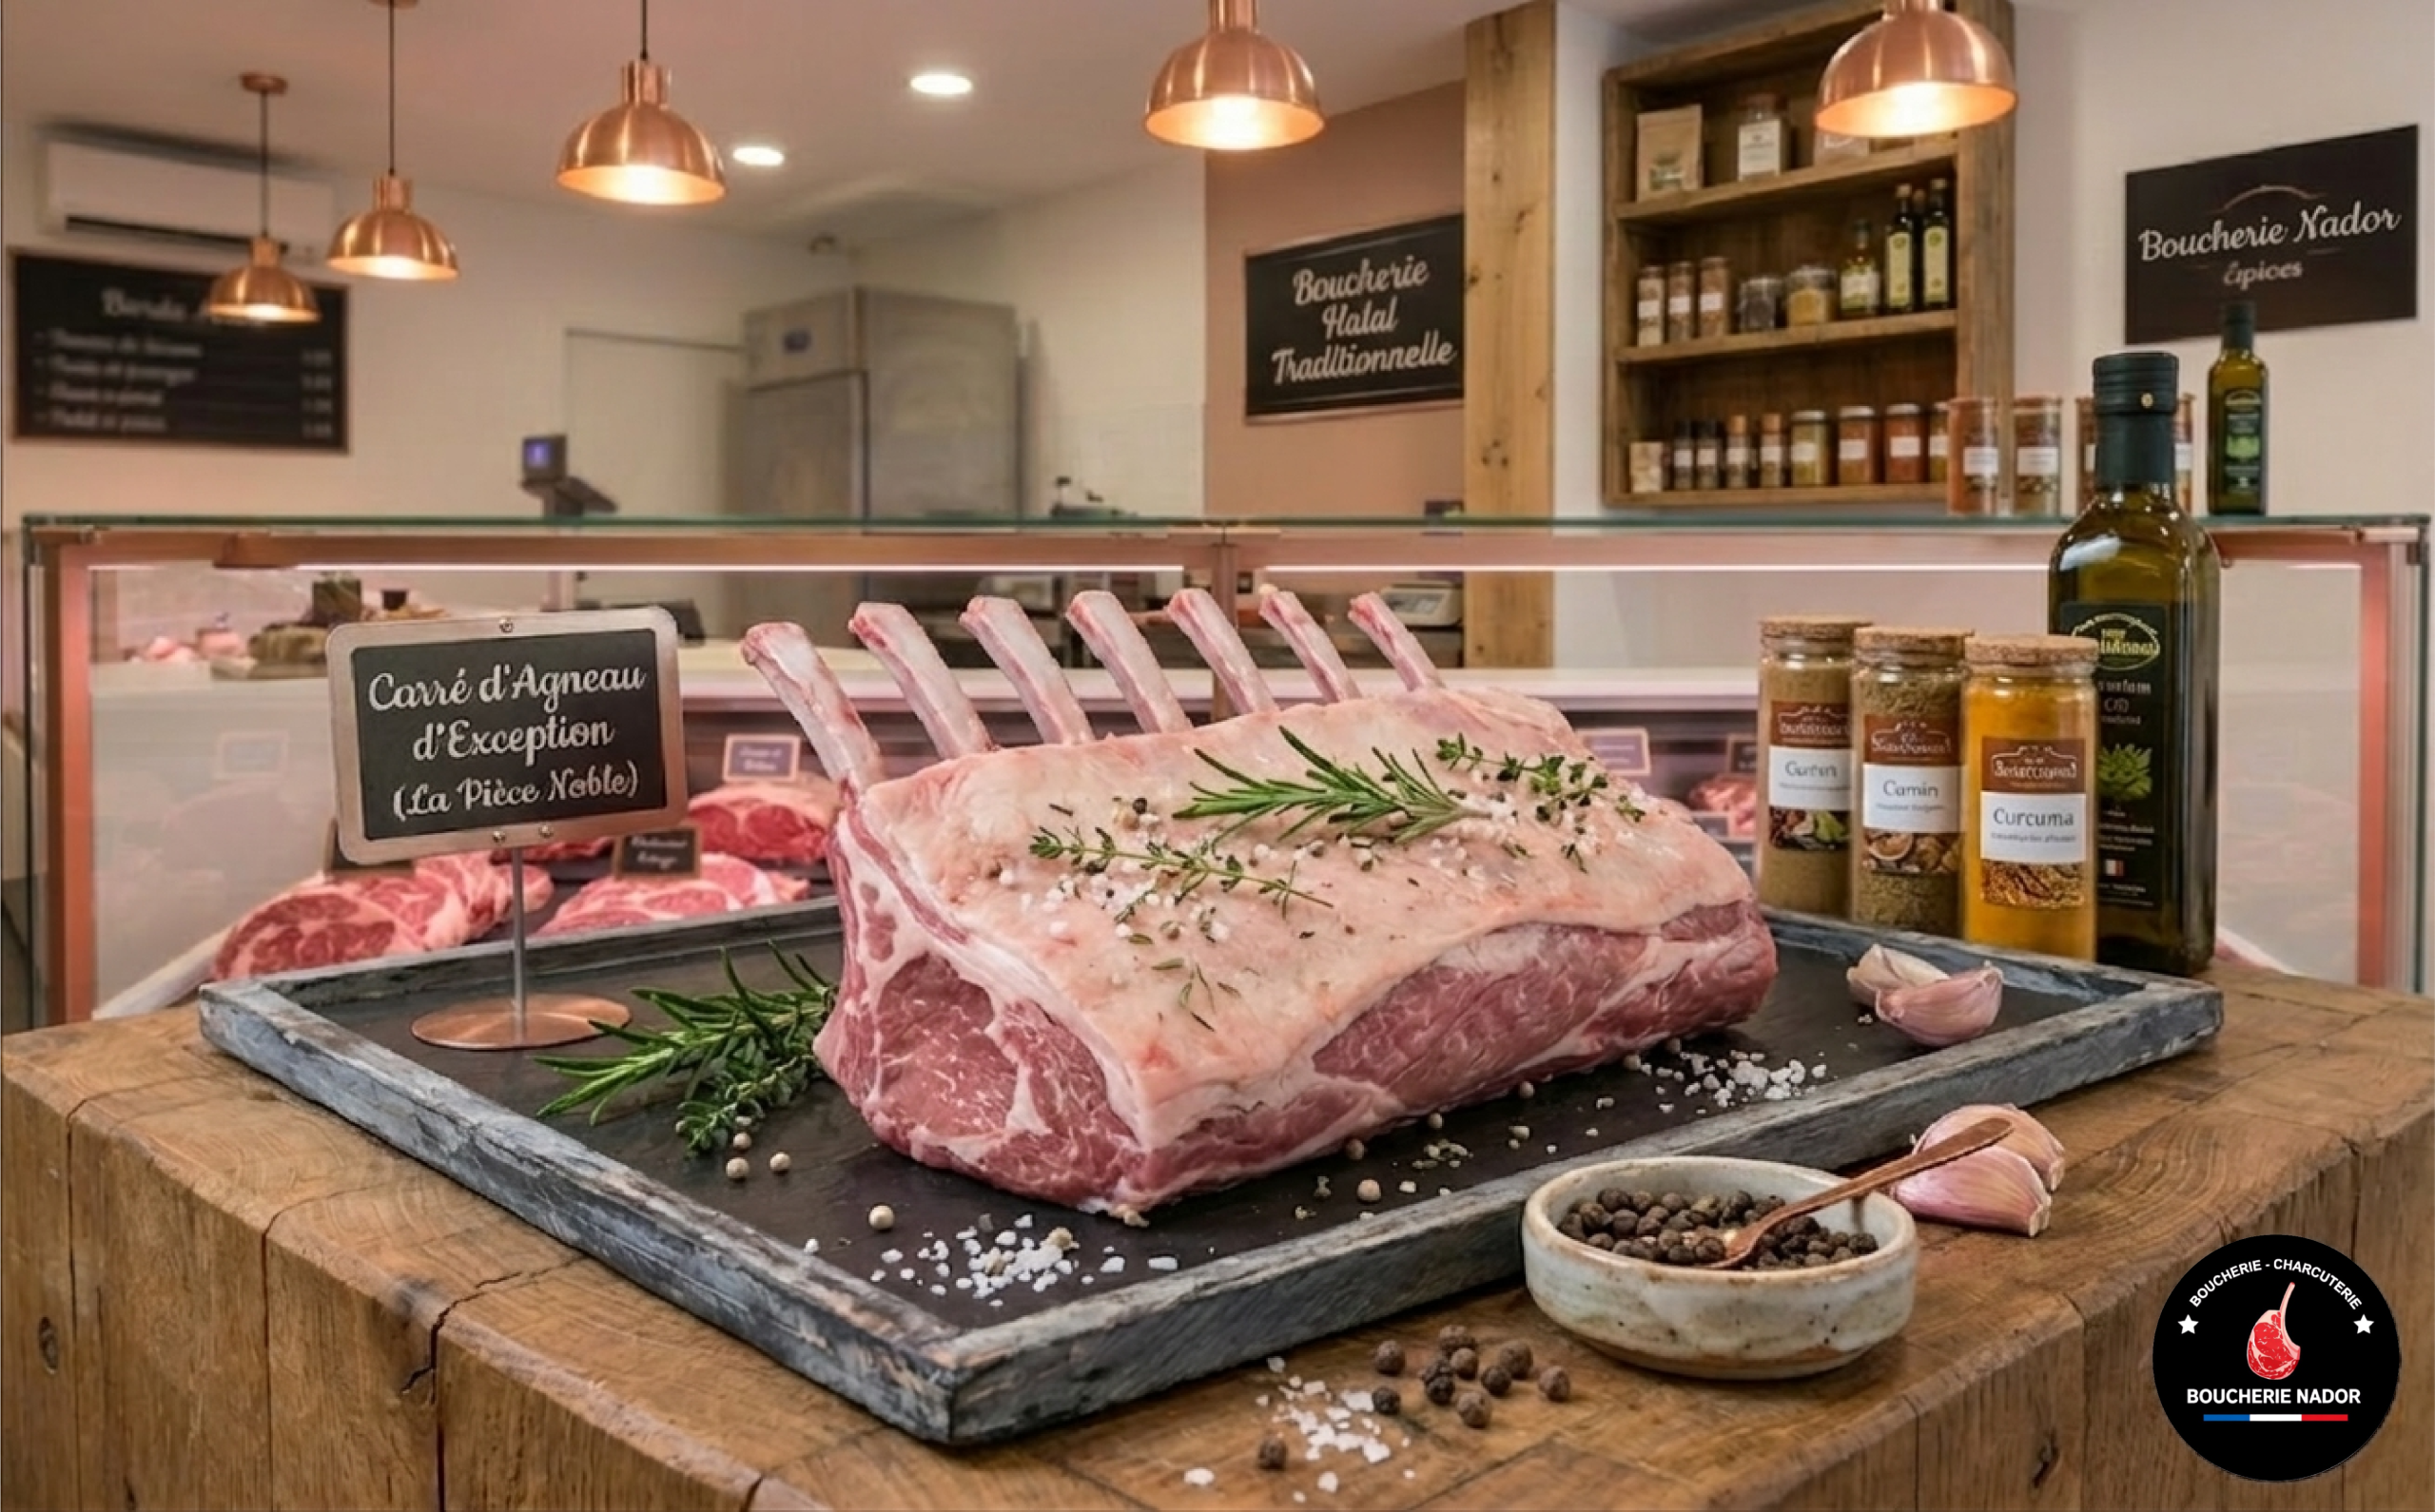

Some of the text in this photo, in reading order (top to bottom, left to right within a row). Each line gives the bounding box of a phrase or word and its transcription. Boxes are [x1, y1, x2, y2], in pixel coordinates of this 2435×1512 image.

[2138, 200, 2402, 262] Boucherie Nador
[1293, 254, 1431, 306] Boucherie
[1321, 295, 1399, 340] Halal
[368, 664, 646, 713] Carré d'Agneau
[413, 716, 614, 767] d'Exception
[393, 785, 452, 822] (La
[547, 760, 638, 801] Noble)
[1993, 807, 2075, 827] Curcuma
